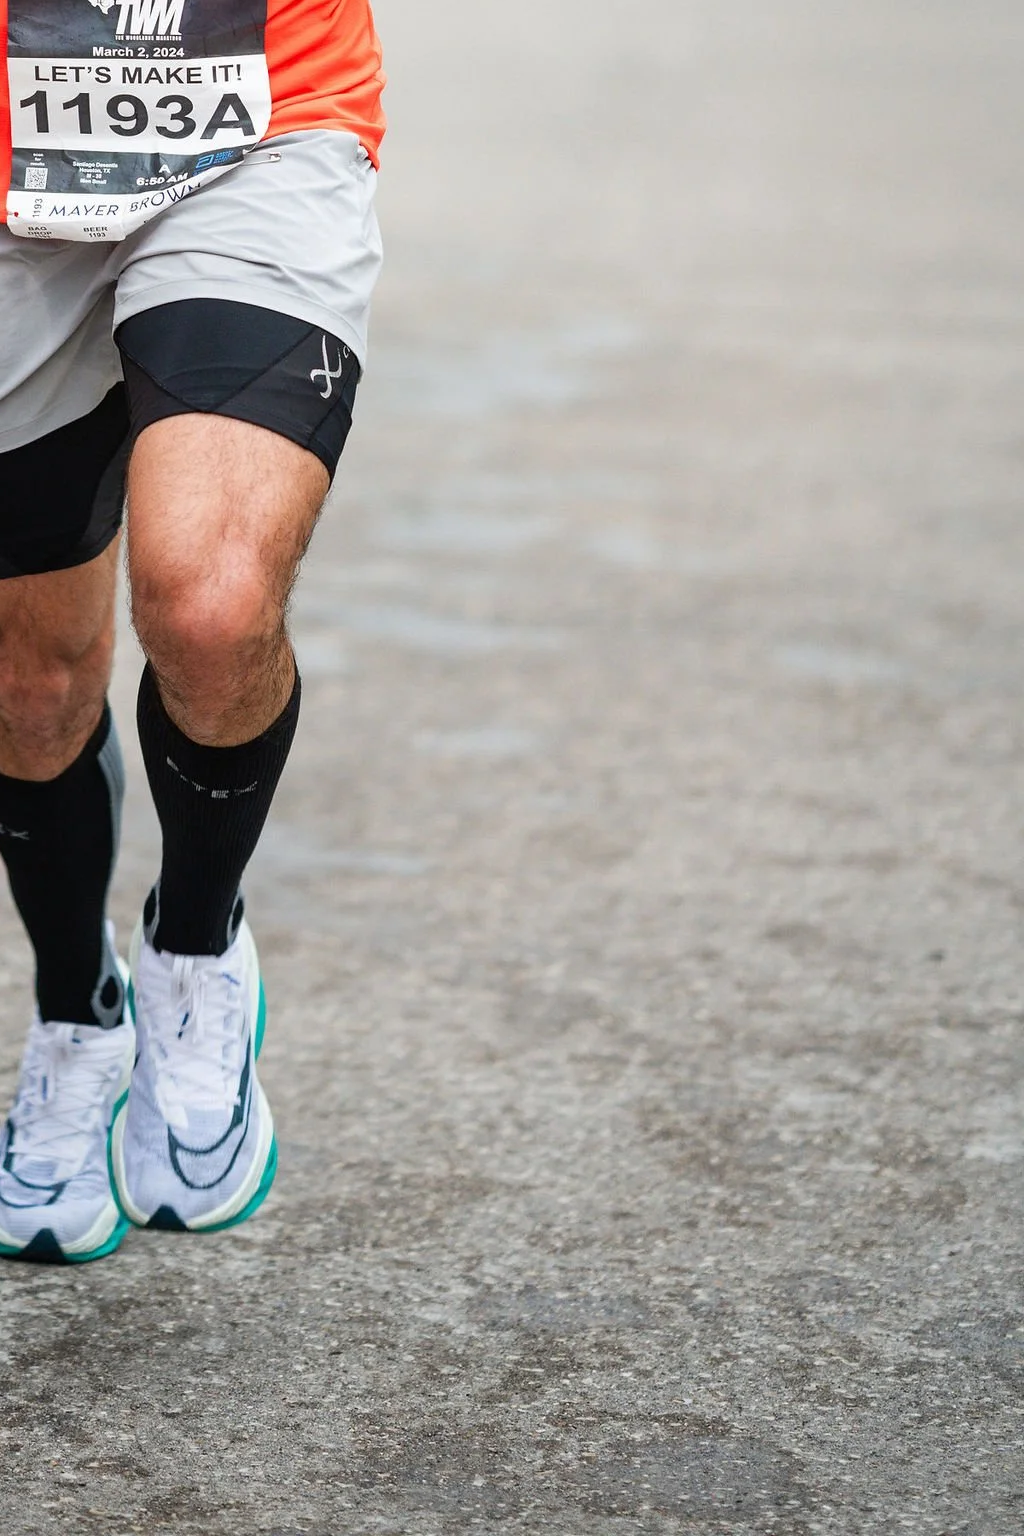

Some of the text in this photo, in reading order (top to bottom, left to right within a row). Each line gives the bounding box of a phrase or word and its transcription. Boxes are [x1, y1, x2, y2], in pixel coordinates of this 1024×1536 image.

[92, 46, 185, 58] March 2, 2024
[34, 64, 242, 84] LET’S MAKE IT!
[19, 89, 257, 140] 1193A
[158, 164, 170, 173] A
[136, 176, 165, 186] 6:50
[166, 172, 189, 183] AM
[32, 197, 43, 218] 1193
[48, 204, 119, 217] MAYER
